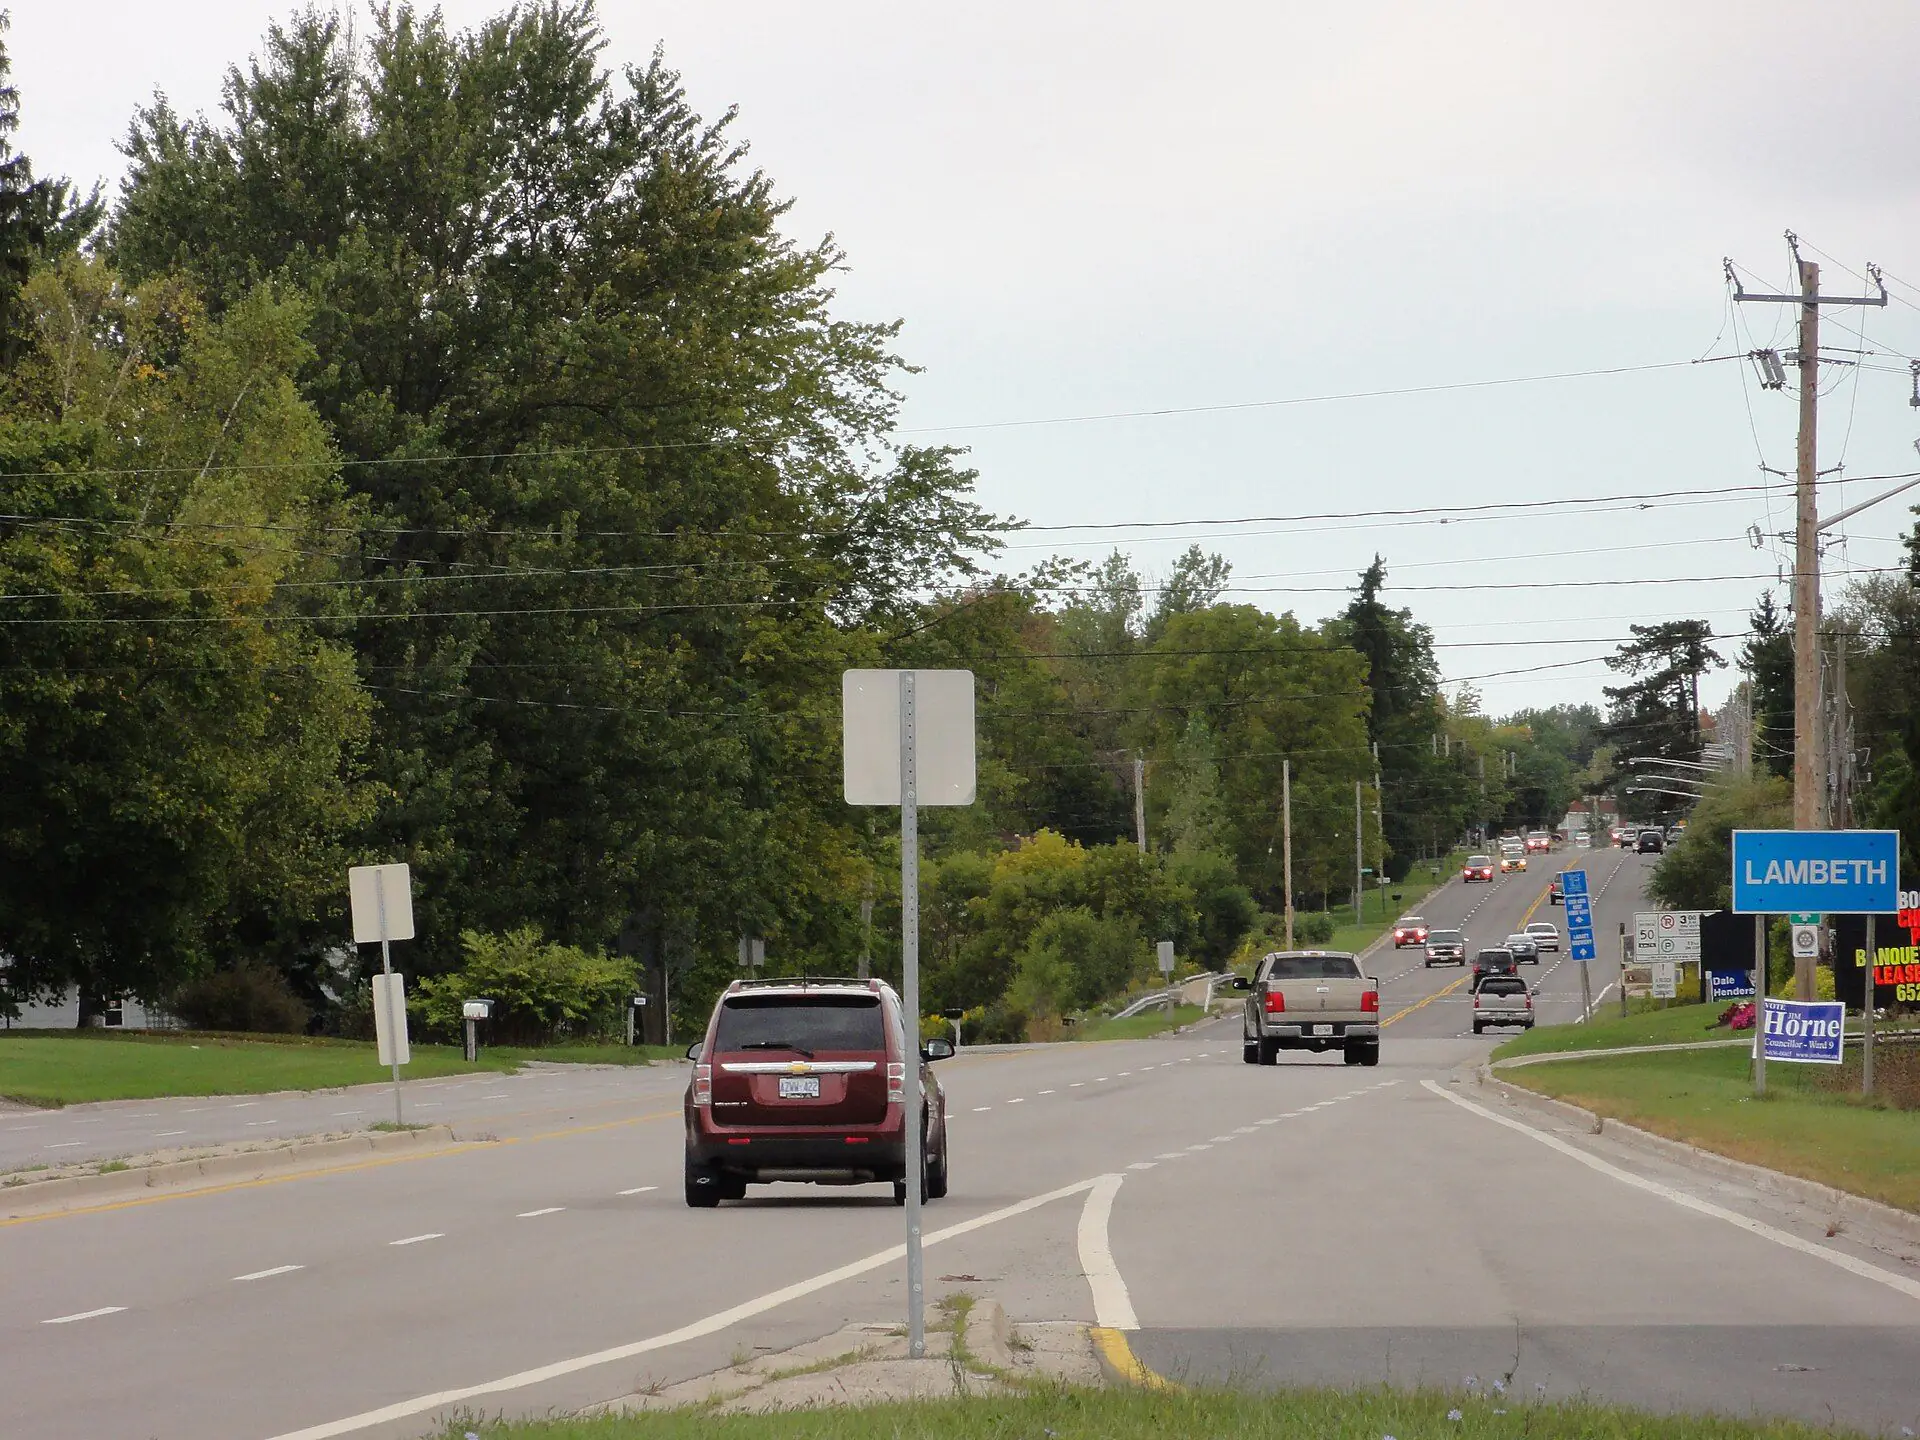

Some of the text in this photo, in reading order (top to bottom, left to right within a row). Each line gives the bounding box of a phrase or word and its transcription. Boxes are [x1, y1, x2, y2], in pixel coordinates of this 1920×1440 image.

[1745, 860, 1887, 885] LAMBETH
[1899, 891, 1920, 910] BO
[1640, 930, 1654, 940] 50
[1855, 946, 1920, 967] BNQUE
[1713, 976, 1735, 986] Dale
[1764, 1002, 1786, 1011] VOTE
[1787, 1012, 1802, 1020] JIM
[1764, 1010, 1840, 1037] Horne
[1764, 1038, 1803, 1049] Councillor
[1809, 1040, 1827, 1049] Ward
[1828, 1041, 1835, 1050] 9
